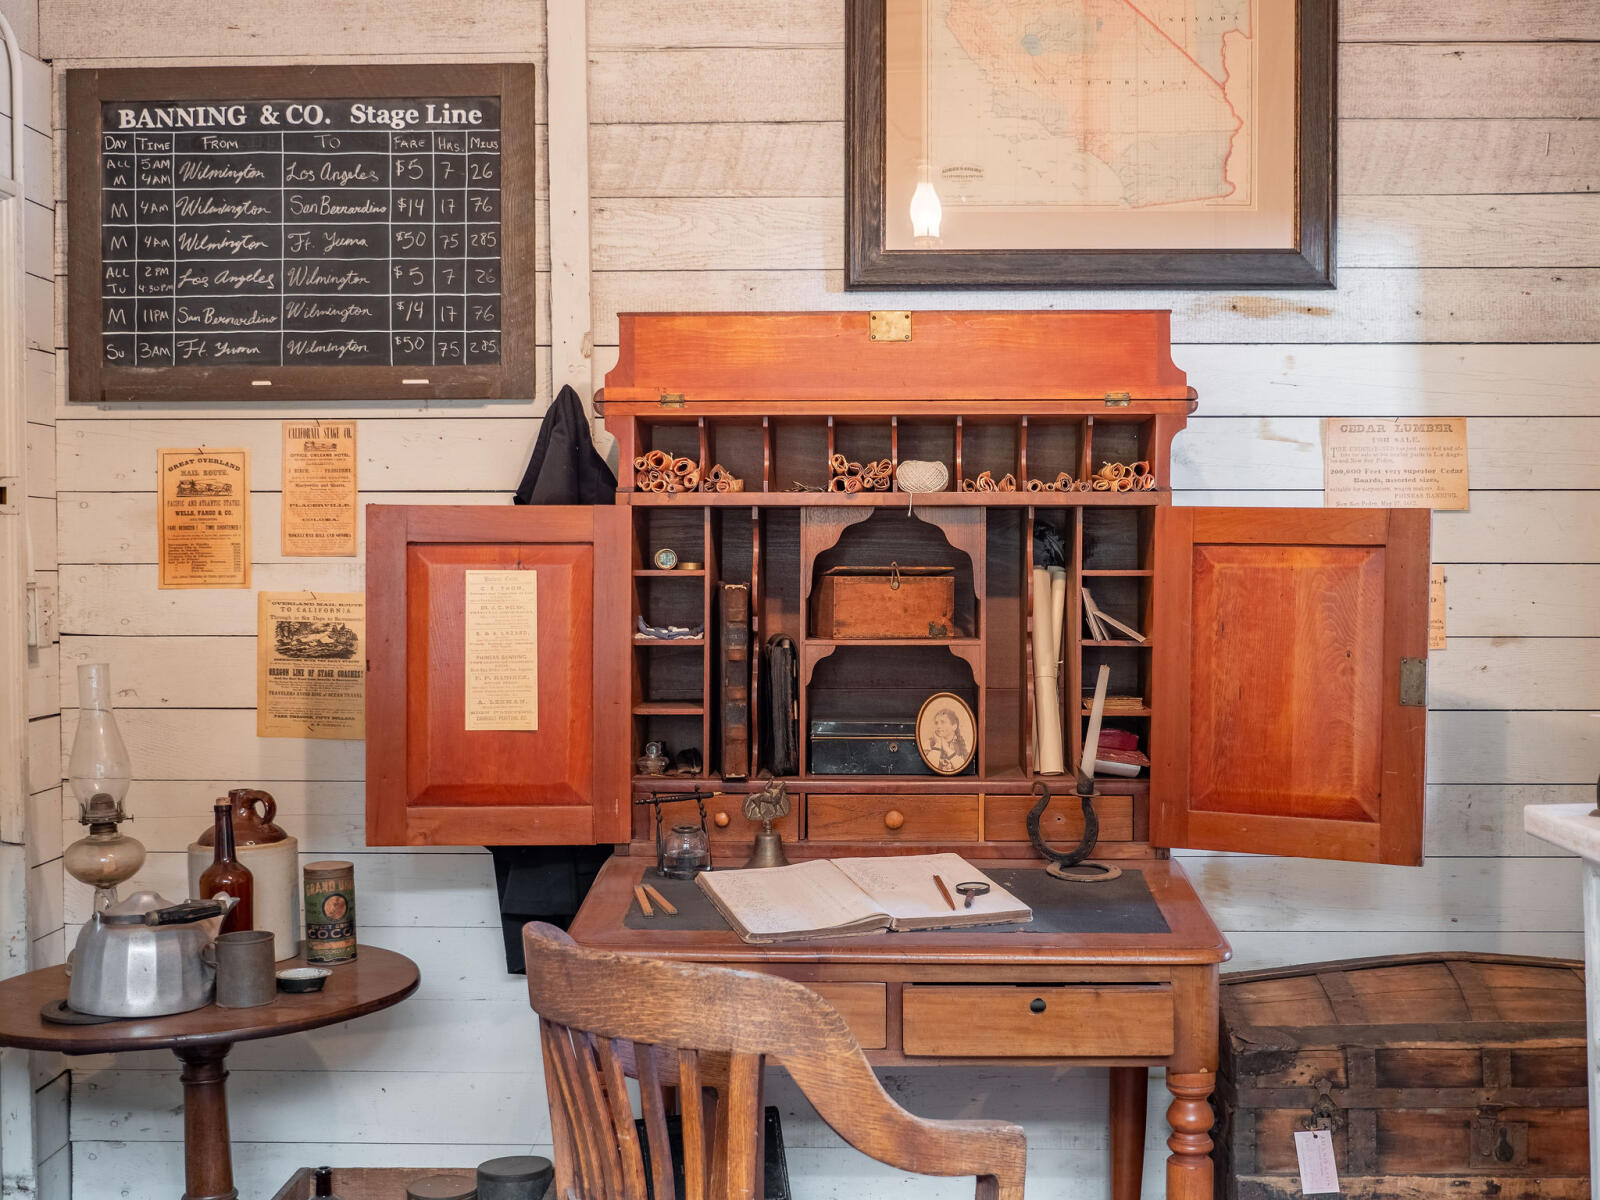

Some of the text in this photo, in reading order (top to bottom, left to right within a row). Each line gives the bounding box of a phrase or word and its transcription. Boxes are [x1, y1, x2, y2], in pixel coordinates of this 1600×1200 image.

[118, 104, 482, 129] BANNING & CO. Stage Line
[202, 136, 239, 150] FROM
[314, 134, 340, 149] TO
[393, 136, 425, 149] FARE
[178, 160, 265, 184] Wilmington
[286, 161, 380, 186] Los Angeles
[396, 158, 424, 180] $5
[440, 162, 455, 180] 7
[470, 162, 494, 180] 26
[113, 174, 127, 186] M
[111, 203, 128, 218] M
[176, 196, 272, 218] Wilmington
[290, 195, 388, 216] San Bernardino
[397, 197, 425, 217] $14
[440, 199, 456, 214] 17
[470, 197, 493, 212] 76
[110, 236, 128, 250] M
[178, 230, 270, 254] Wilmington
[323, 232, 369, 254] Yuma
[396, 232, 426, 250] $50
[440, 233, 460, 250] 75
[470, 232, 497, 248] 285
[106, 266, 130, 278] ALL
[178, 268, 274, 289] Los Angeles
[288, 266, 370, 290] Wilmington
[442, 269, 456, 285] 7
[475, 268, 496, 284] 26
[108, 308, 126, 325] M
[178, 307, 278, 326] San Bernardino
[286, 301, 372, 322] Wilmington
[396, 301, 424, 321] $14
[440, 306, 458, 322] 17
[472, 305, 494, 321] 76
[214, 342, 261, 356] Yuma
[286, 338, 369, 358] Wilmington
[395, 337, 425, 352] $50
[438, 342, 460, 358] 75
[470, 340, 496, 354] 285
[324, 427, 339, 440] STAGE
[1340, 424, 1453, 433] CEDAR LUMBER
[168, 458, 241, 472] GREAT OVERLAND
[306, 880, 336, 896] GRAND
